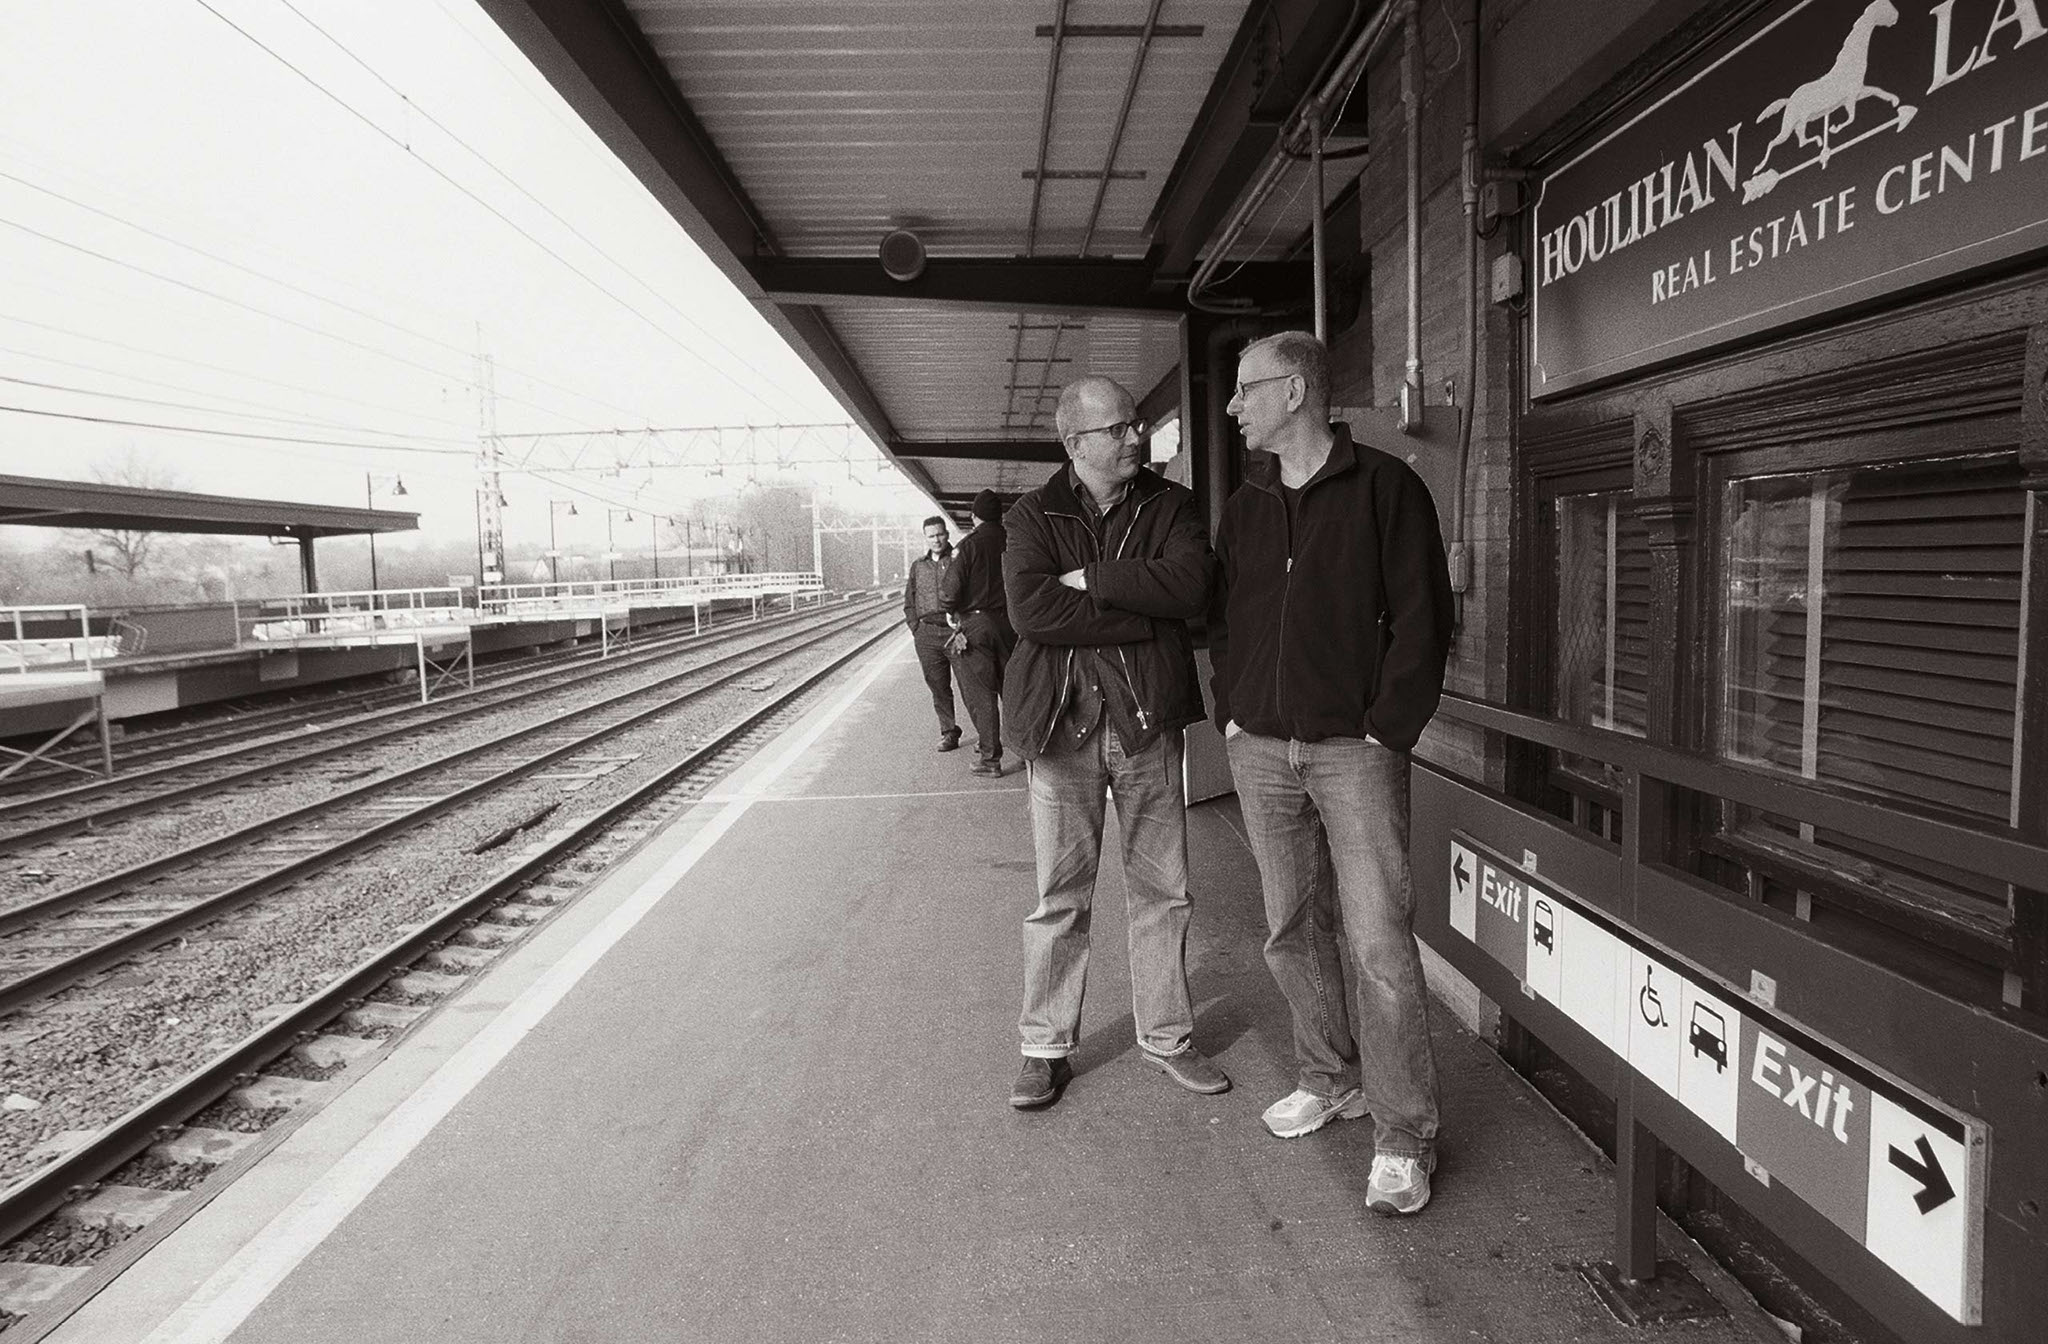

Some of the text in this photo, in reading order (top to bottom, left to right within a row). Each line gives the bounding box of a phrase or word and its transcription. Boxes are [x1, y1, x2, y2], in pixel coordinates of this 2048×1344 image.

[1542, 122, 1742, 287] HOULIHAN
[1652, 249, 1716, 305] REAL
[1729, 186, 1856, 275] ESTATE
[1481, 864, 1522, 923] Exit
[1751, 1030, 1854, 1145] Exit
